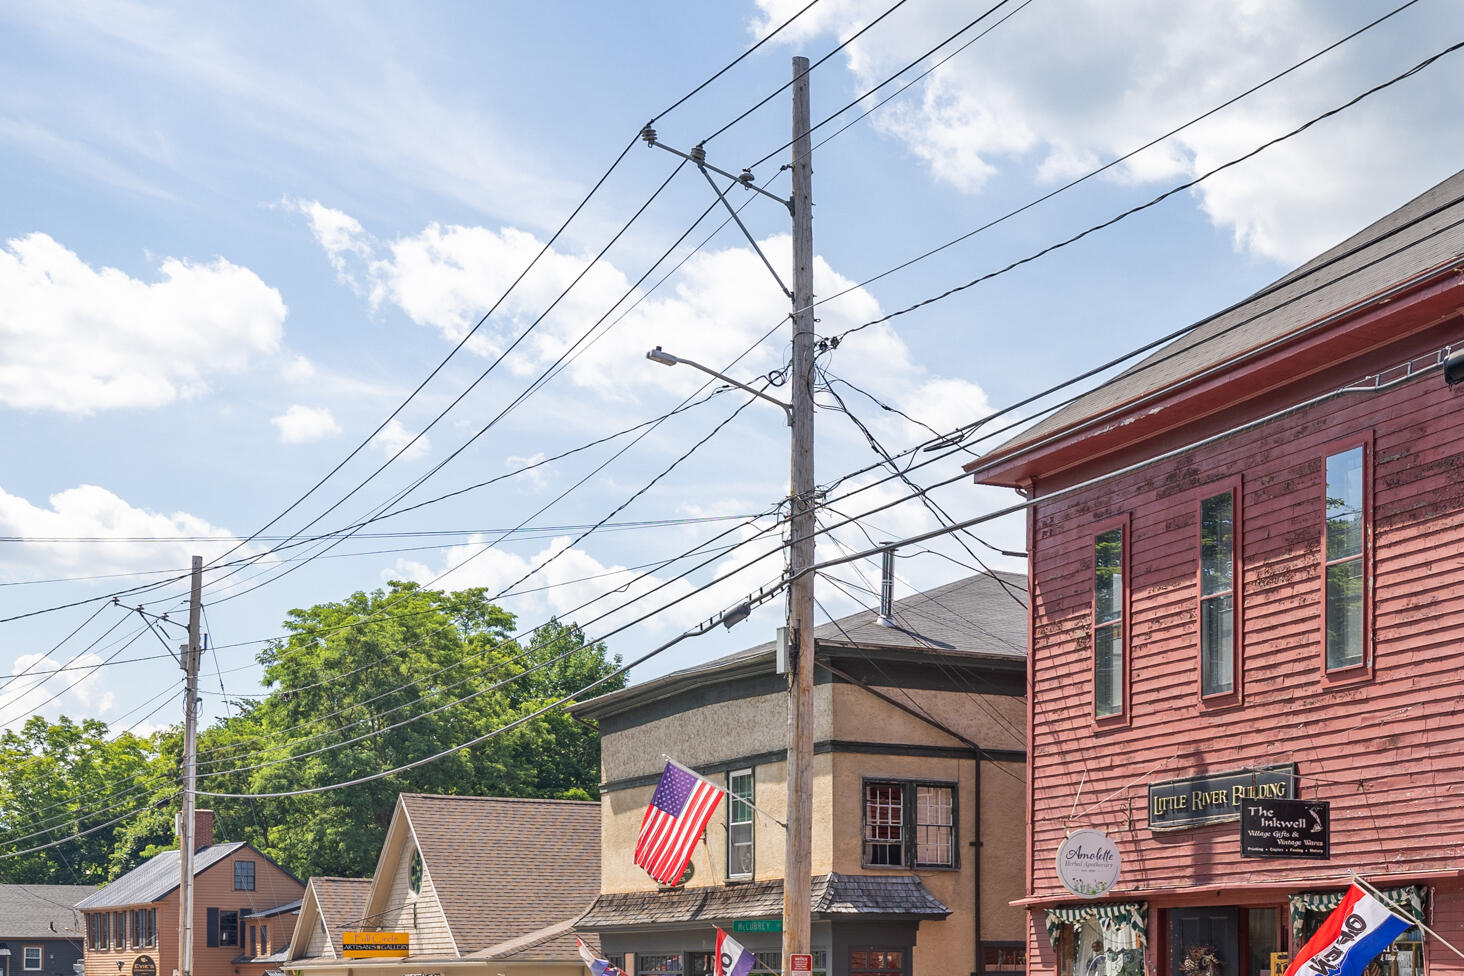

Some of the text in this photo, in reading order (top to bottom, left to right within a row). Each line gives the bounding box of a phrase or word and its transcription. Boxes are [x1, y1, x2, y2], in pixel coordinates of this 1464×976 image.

[1153, 781, 1287, 816] LITTLE RIVER BUILDING
[1247, 806, 1274, 817] The
[1261, 817, 1306, 829] Inkwell
[1247, 830, 1272, 838] Village
[1272, 830, 1290, 839] Gifts
[1276, 839, 1302, 847] Vintage
[1065, 845, 1114, 863] Amolette
